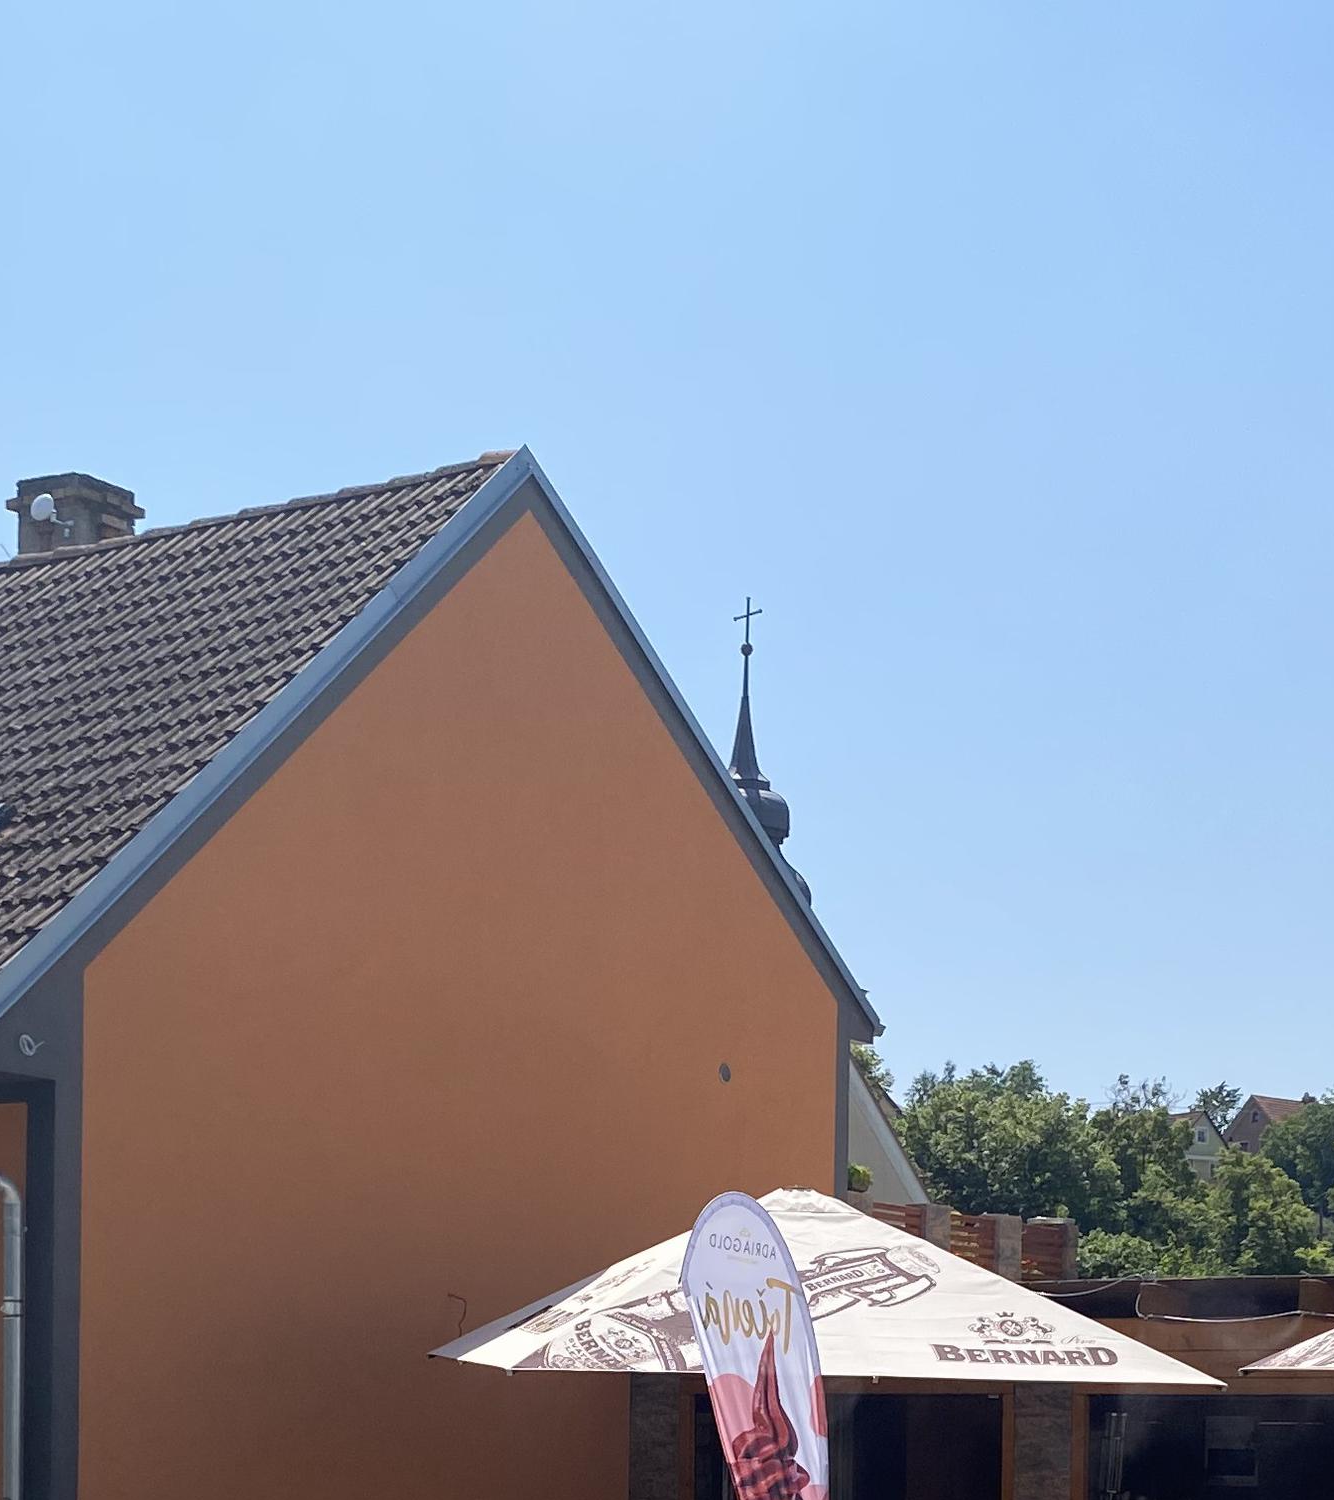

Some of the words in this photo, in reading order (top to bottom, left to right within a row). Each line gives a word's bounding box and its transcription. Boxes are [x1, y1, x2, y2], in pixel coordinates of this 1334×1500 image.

[804, 1269, 865, 1292] BERNARD
[574, 1319, 626, 1371] BERNA
[930, 1343, 1119, 1367] BERNARD
